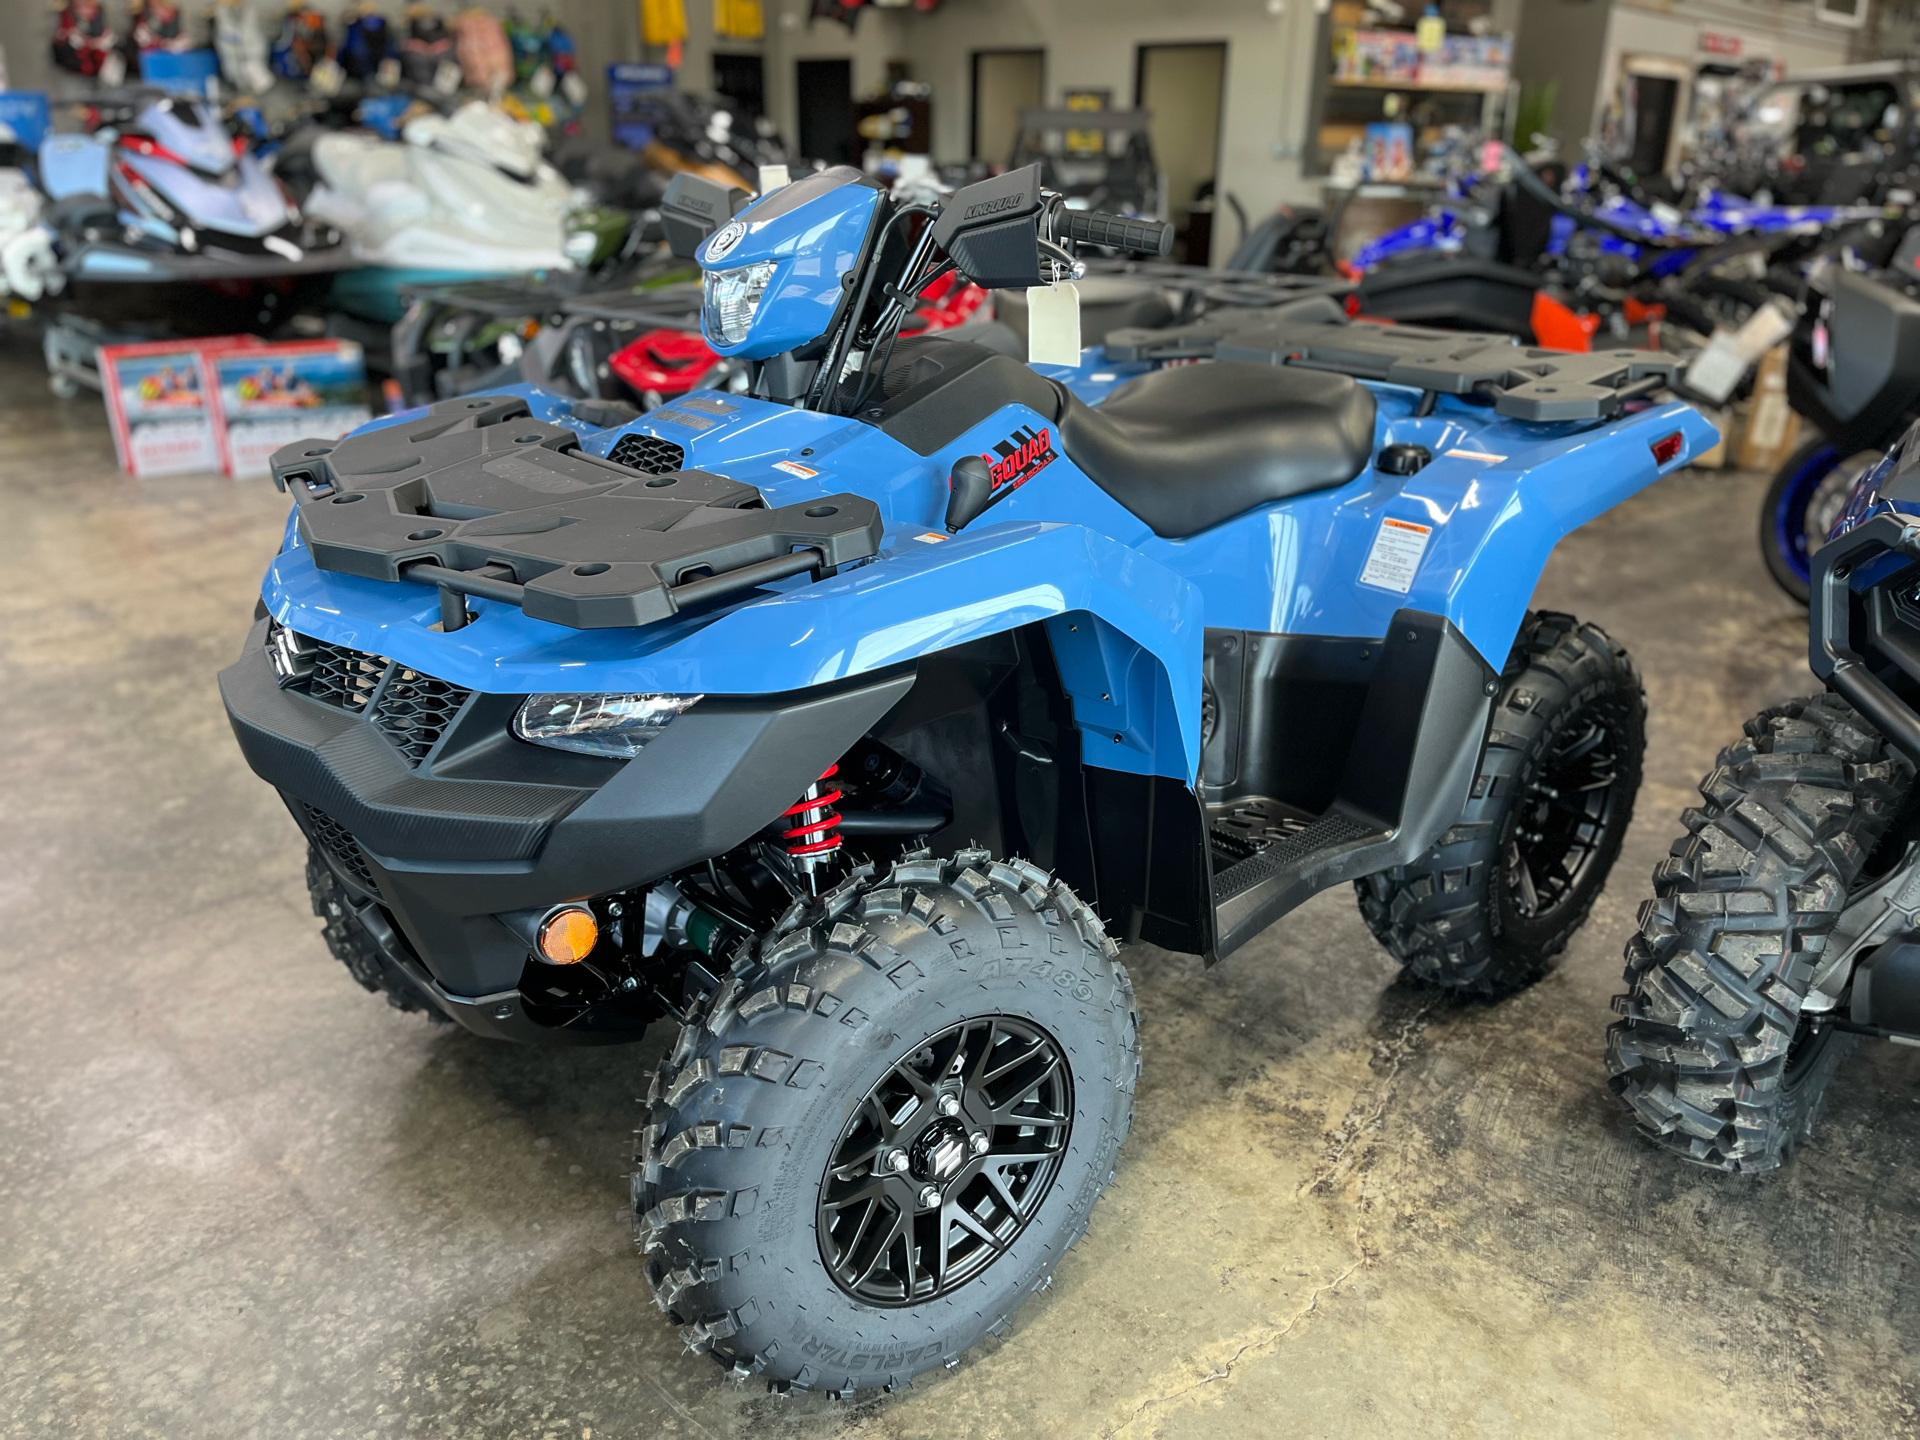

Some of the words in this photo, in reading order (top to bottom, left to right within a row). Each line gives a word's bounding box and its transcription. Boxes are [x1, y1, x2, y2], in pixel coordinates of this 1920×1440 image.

[964, 193, 1024, 220] KINGQUAD
[971, 956, 1094, 1003] AT489
[801, 1335, 943, 1372] CARLSTAR
